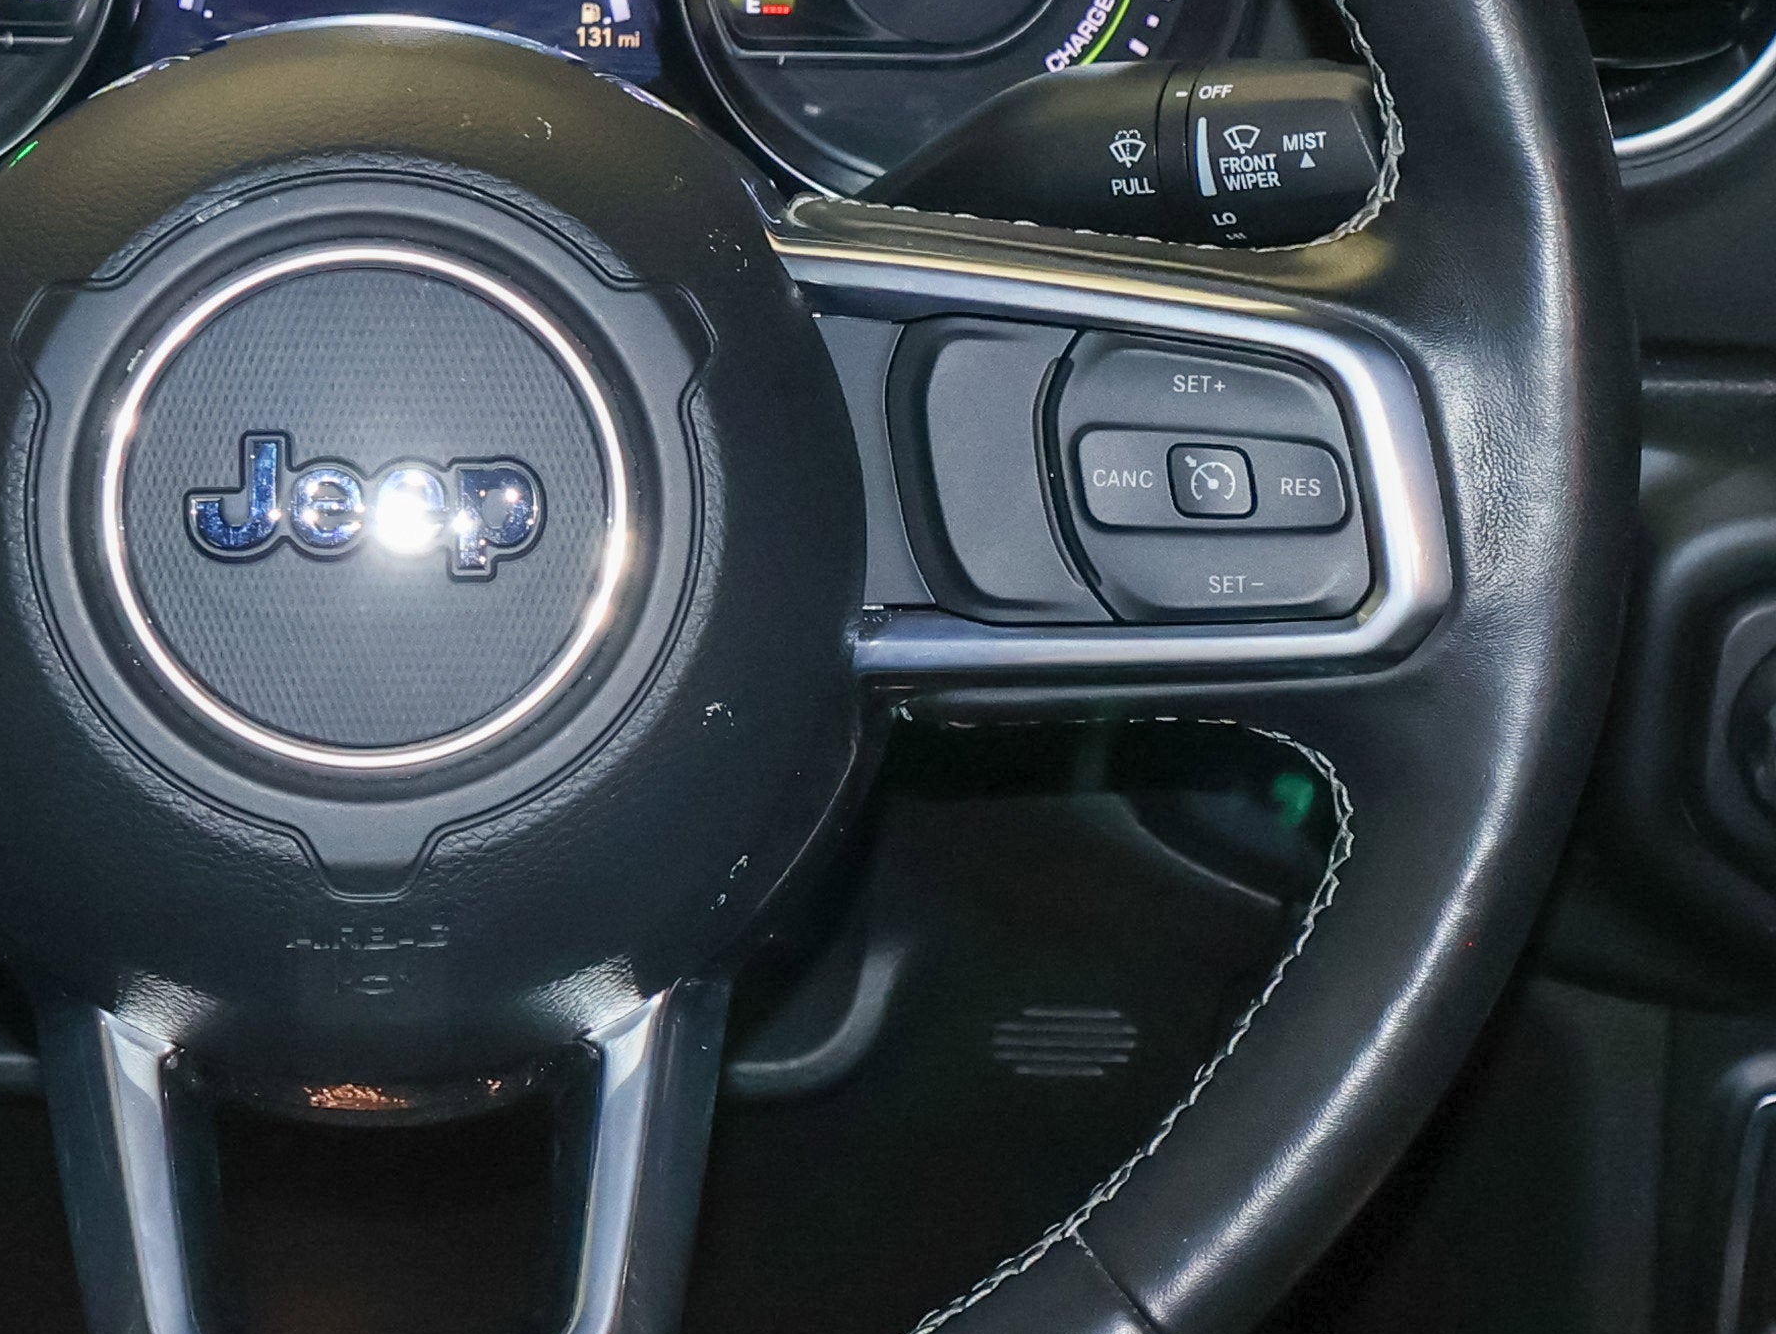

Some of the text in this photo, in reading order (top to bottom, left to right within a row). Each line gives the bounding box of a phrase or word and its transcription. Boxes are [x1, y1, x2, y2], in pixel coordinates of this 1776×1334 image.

[576, 27, 640, 48] 131 mi
[1198, 84, 1233, 99] OFF
[1282, 131, 1326, 152] MIST
[1219, 153, 1277, 174] FRONT
[1110, 178, 1156, 196] PULL
[1223, 171, 1281, 191] WIPER
[1212, 212, 1237, 226] LO
[1172, 374, 1226, 394] SET+
[1092, 469, 1154, 489] CANC
[1280, 477, 1321, 497] RES
[188, 437, 542, 575] Jeep
